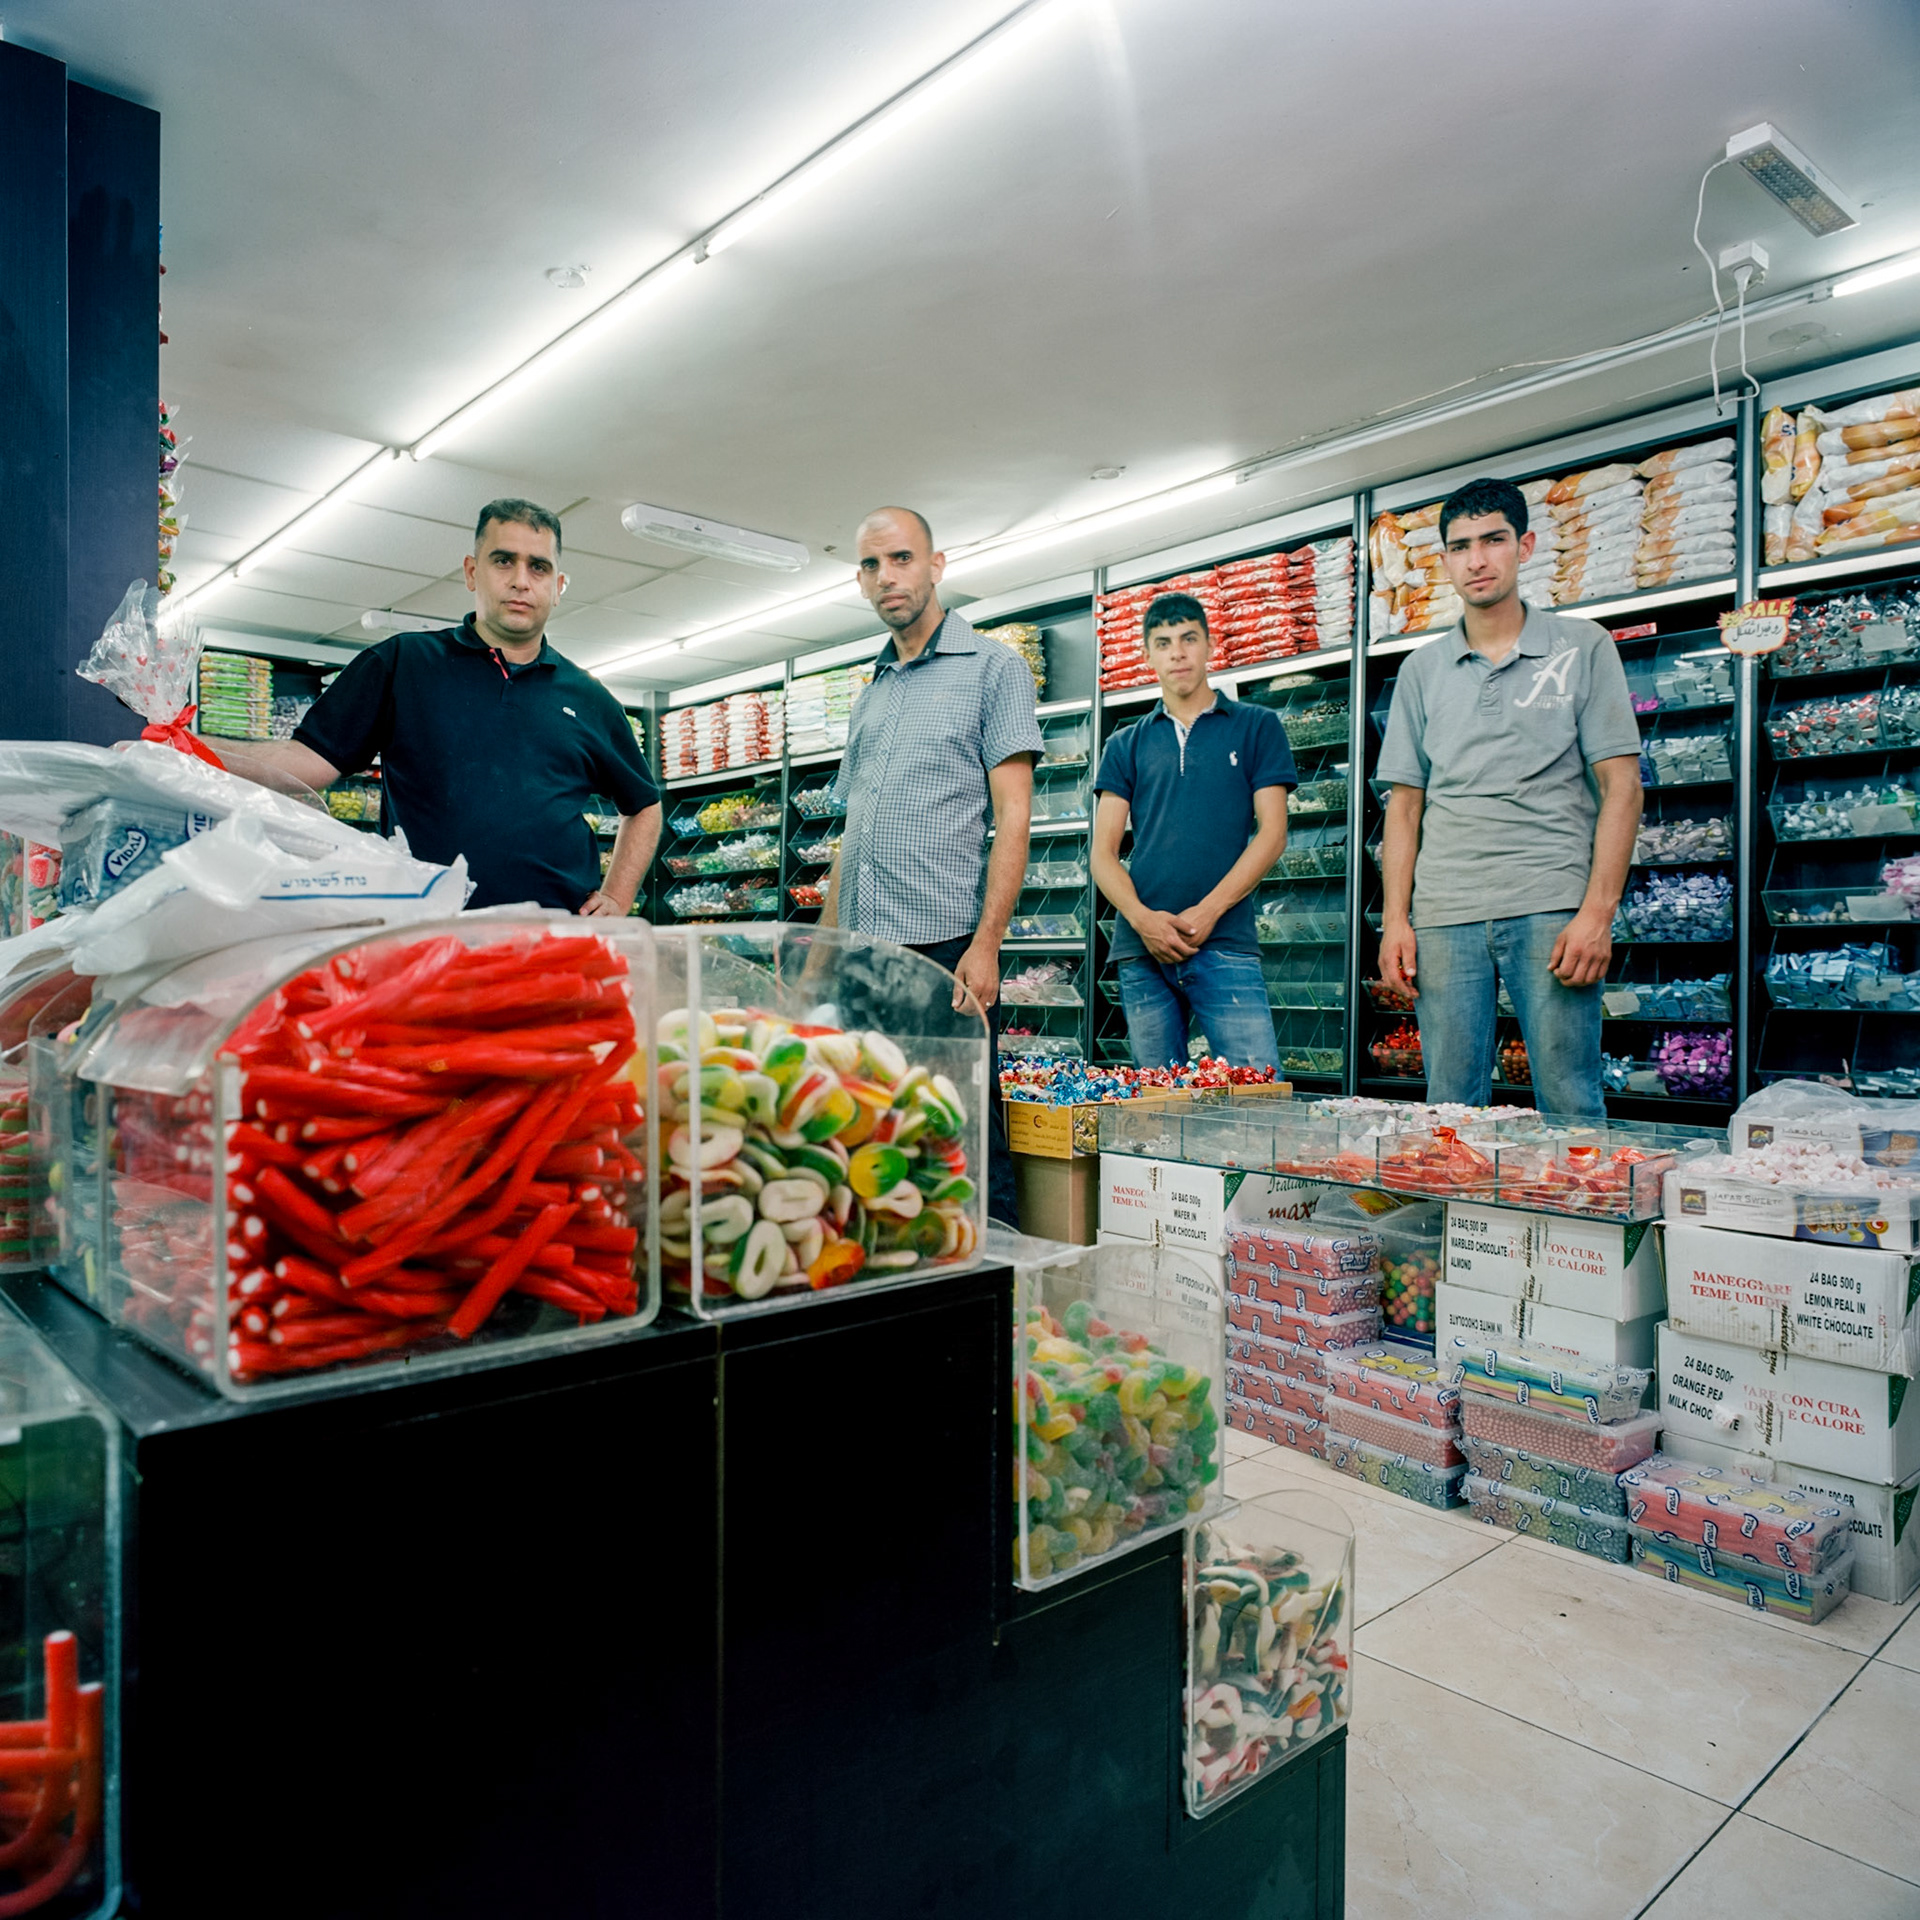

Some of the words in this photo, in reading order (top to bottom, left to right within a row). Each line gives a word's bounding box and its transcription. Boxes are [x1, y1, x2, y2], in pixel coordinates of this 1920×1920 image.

[1743, 600, 1792, 618] SALE
[1513, 647, 1579, 708] A
[111, 835, 142, 867] VIDAL
[1178, 1193, 1188, 1203] BAG
[1164, 1224, 1177, 1235] MILK
[1178, 1226, 1207, 1241] CHOCOLATE
[1450, 1216, 1457, 1228] 24
[1469, 1219, 1479, 1232] 500
[1480, 1221, 1488, 1233] GR
[1450, 1236, 1474, 1251] MARBLED
[1475, 1240, 1508, 1257] CHOCOLATE
[1571, 1247, 1604, 1262] CURA
[1450, 1256, 1472, 1271] ALMOND
[1557, 1259, 1607, 1276] CALORE
[1690, 1284, 1731, 1301] TEME
[1810, 1272, 1819, 1284] 24
[1821, 1273, 1838, 1287] BAG
[1840, 1276, 1855, 1290] 500
[1856, 1282, 1861, 1295] g
[1804, 1292, 1832, 1309] LEMON
[1834, 1297, 1855, 1313] PEAL
[1857, 1302, 1866, 1315] IN
[1450, 1313, 1479, 1329] CHOCOLATE
[1796, 1313, 1822, 1329] WHITE
[1824, 1318, 1873, 1339] CHOCOLATE
[1486, 1353, 1495, 1374] VIDAL
[1684, 1355, 1695, 1369] 24
[1696, 1360, 1713, 1376] BAG
[1672, 1373, 1706, 1396] ORANGE
[1587, 1399, 1599, 1423] VIDAL
[1668, 1393, 1688, 1411] MILK
[1781, 1393, 1814, 1409] CON
[1817, 1400, 1862, 1419] CURA
[1788, 1409, 1797, 1421] E
[1801, 1412, 1866, 1435] CALORE
[1668, 1491, 1677, 1513] VIDAL
[1788, 1572, 1797, 1595] VIDA
